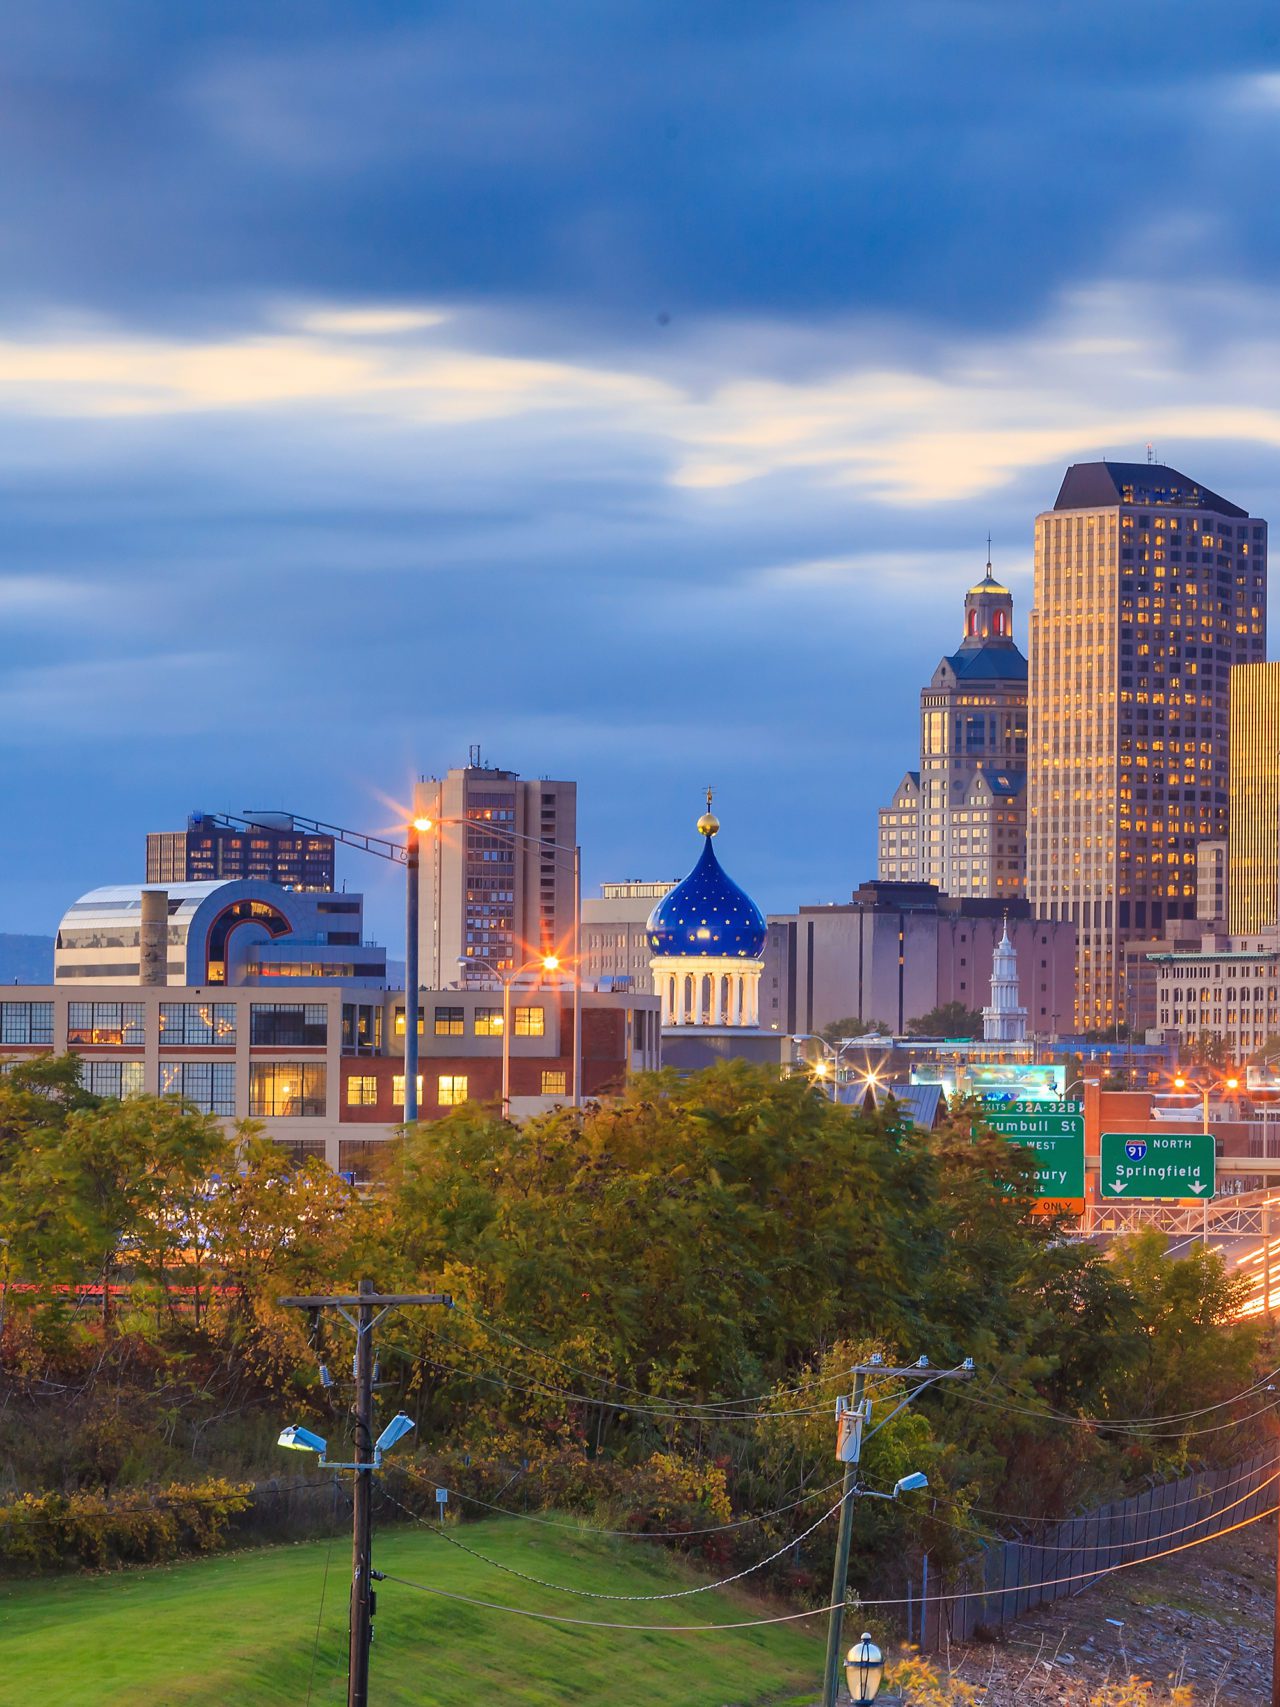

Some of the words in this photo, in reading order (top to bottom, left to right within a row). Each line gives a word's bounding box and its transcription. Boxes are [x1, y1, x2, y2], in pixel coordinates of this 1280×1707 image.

[1016, 1103, 1075, 1113] 32A-32B
[1061, 1121, 1076, 1132] St
[1026, 1142, 1056, 1150] WEST
[1153, 1139, 1192, 1148] NORTH
[1128, 1146, 1142, 1157] 91
[1116, 1165, 1200, 1180] Springfield
